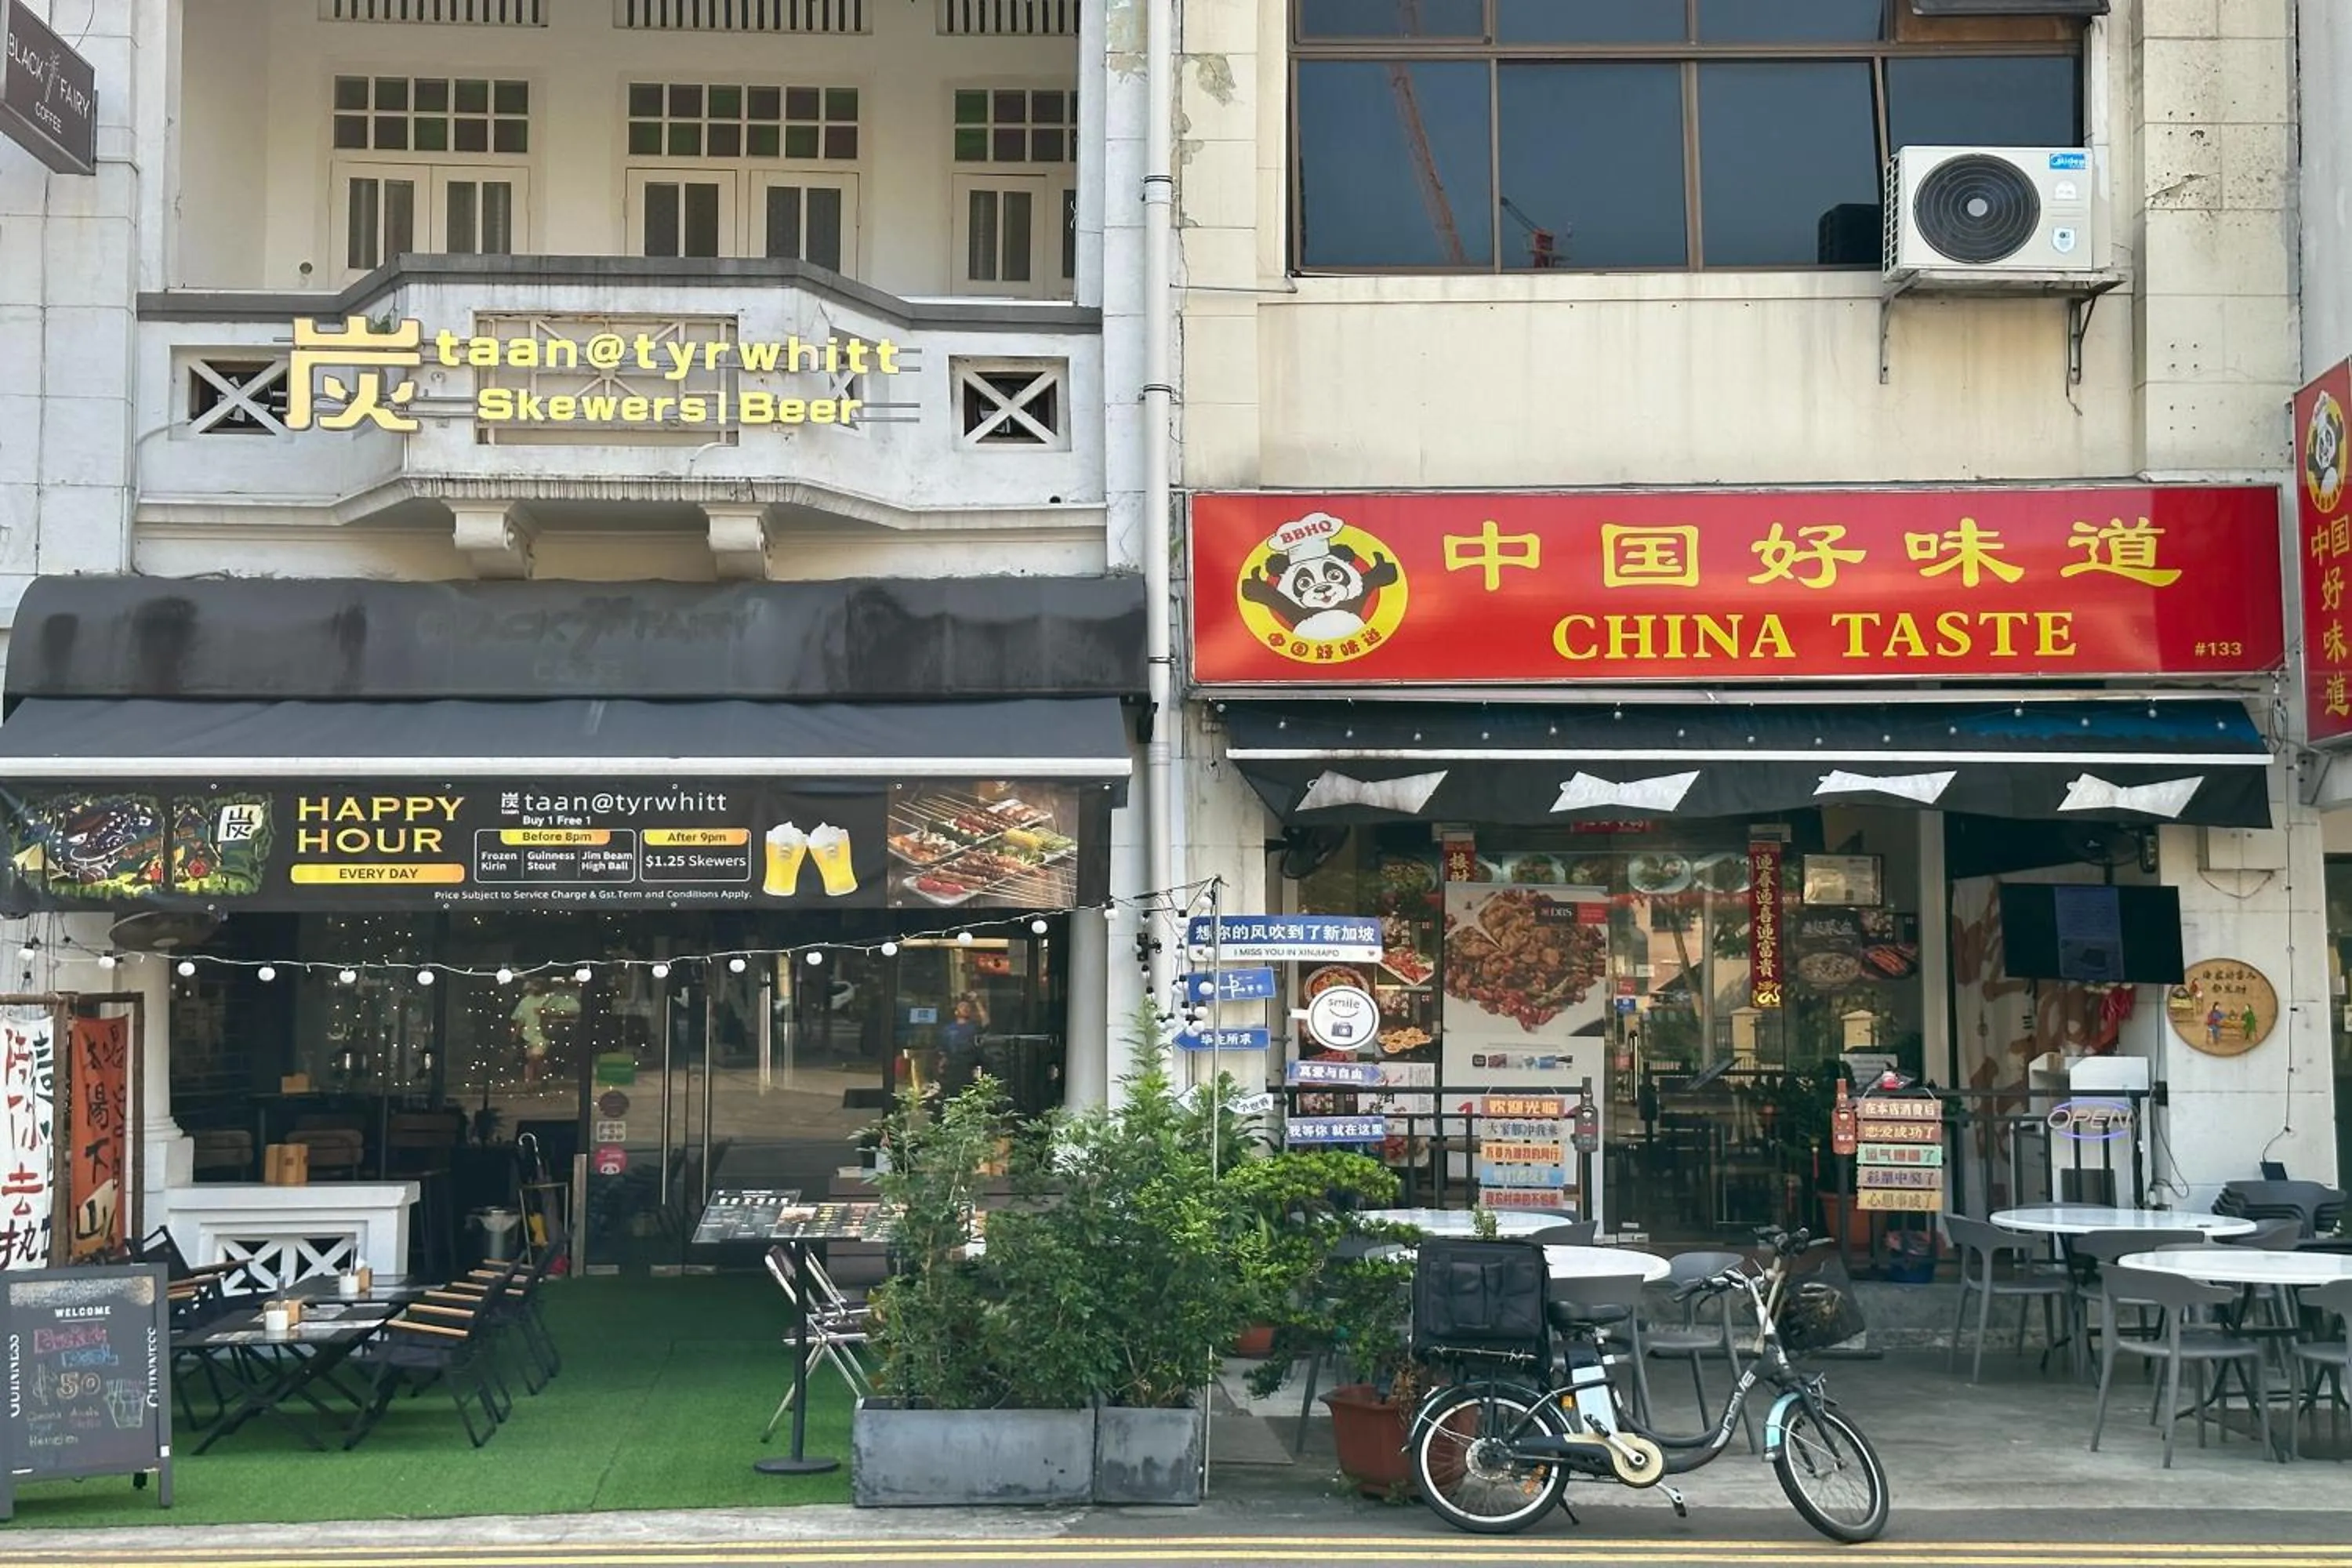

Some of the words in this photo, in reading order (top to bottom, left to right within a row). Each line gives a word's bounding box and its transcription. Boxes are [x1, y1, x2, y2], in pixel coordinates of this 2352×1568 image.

[8, 32, 45, 82] BLACK
[60, 78, 90, 119] FAIRY
[35, 101, 62, 134] COFFEE
[436, 328, 900, 380] taan@tyrwhitt
[285, 315, 422, 432] 炭
[477, 388, 710, 423] Skewers
[739, 392, 864, 424] Beer
[1279, 520, 1334, 545] BBHQ
[1443, 517, 2183, 590] 中国好味道
[2310, 514, 2350, 717] 中国好味道
[1552, 613, 1795, 659] CHINA
[1831, 612, 2077, 657] TASTE
[2194, 641, 2243, 657] #133
[297, 796, 465, 822] HAPPY
[525, 791, 728, 815] taan@tyrwhitt
[522, 815, 546, 827] Buy
[548, 815, 554, 826] 1
[557, 815, 583, 826] Free
[586, 815, 591, 826] 1
[297, 828, 443, 854] HOUR
[522, 831, 562, 842] Before
[565, 831, 593, 844] 8pm
[667, 831, 697, 842] After
[700, 832, 727, 845] 9pm
[481, 851, 517, 861] Frozen
[527, 851, 575, 861] Guinness
[582, 851, 601, 861] Jim
[604, 851, 633, 861] Beam
[645, 855, 685, 868] $1.25
[688, 855, 746, 867] Skewers
[339, 867, 387, 880] EVERY
[391, 867, 418, 880] DAY
[481, 862, 507, 871] Kirin
[527, 862, 557, 871] Stout
[582, 862, 606, 873] High
[608, 861, 629, 871] Ball
[462, 891, 499, 901] Subject
[514, 891, 549, 899] Service
[551, 891, 587, 901] Charge
[644, 890, 665, 898] and
[666, 890, 719, 899] Conditions
[720, 890, 753, 901] Apply.
[1196, 924, 1375, 942] 想你的风吹到了新加坡
[1265, 948, 1286, 956] YOU
[1489, 1100, 1559, 1114] 欢迎光临
[2048, 1109, 2132, 1129] OPEN
[54, 1306, 111, 1318] WELCOME
